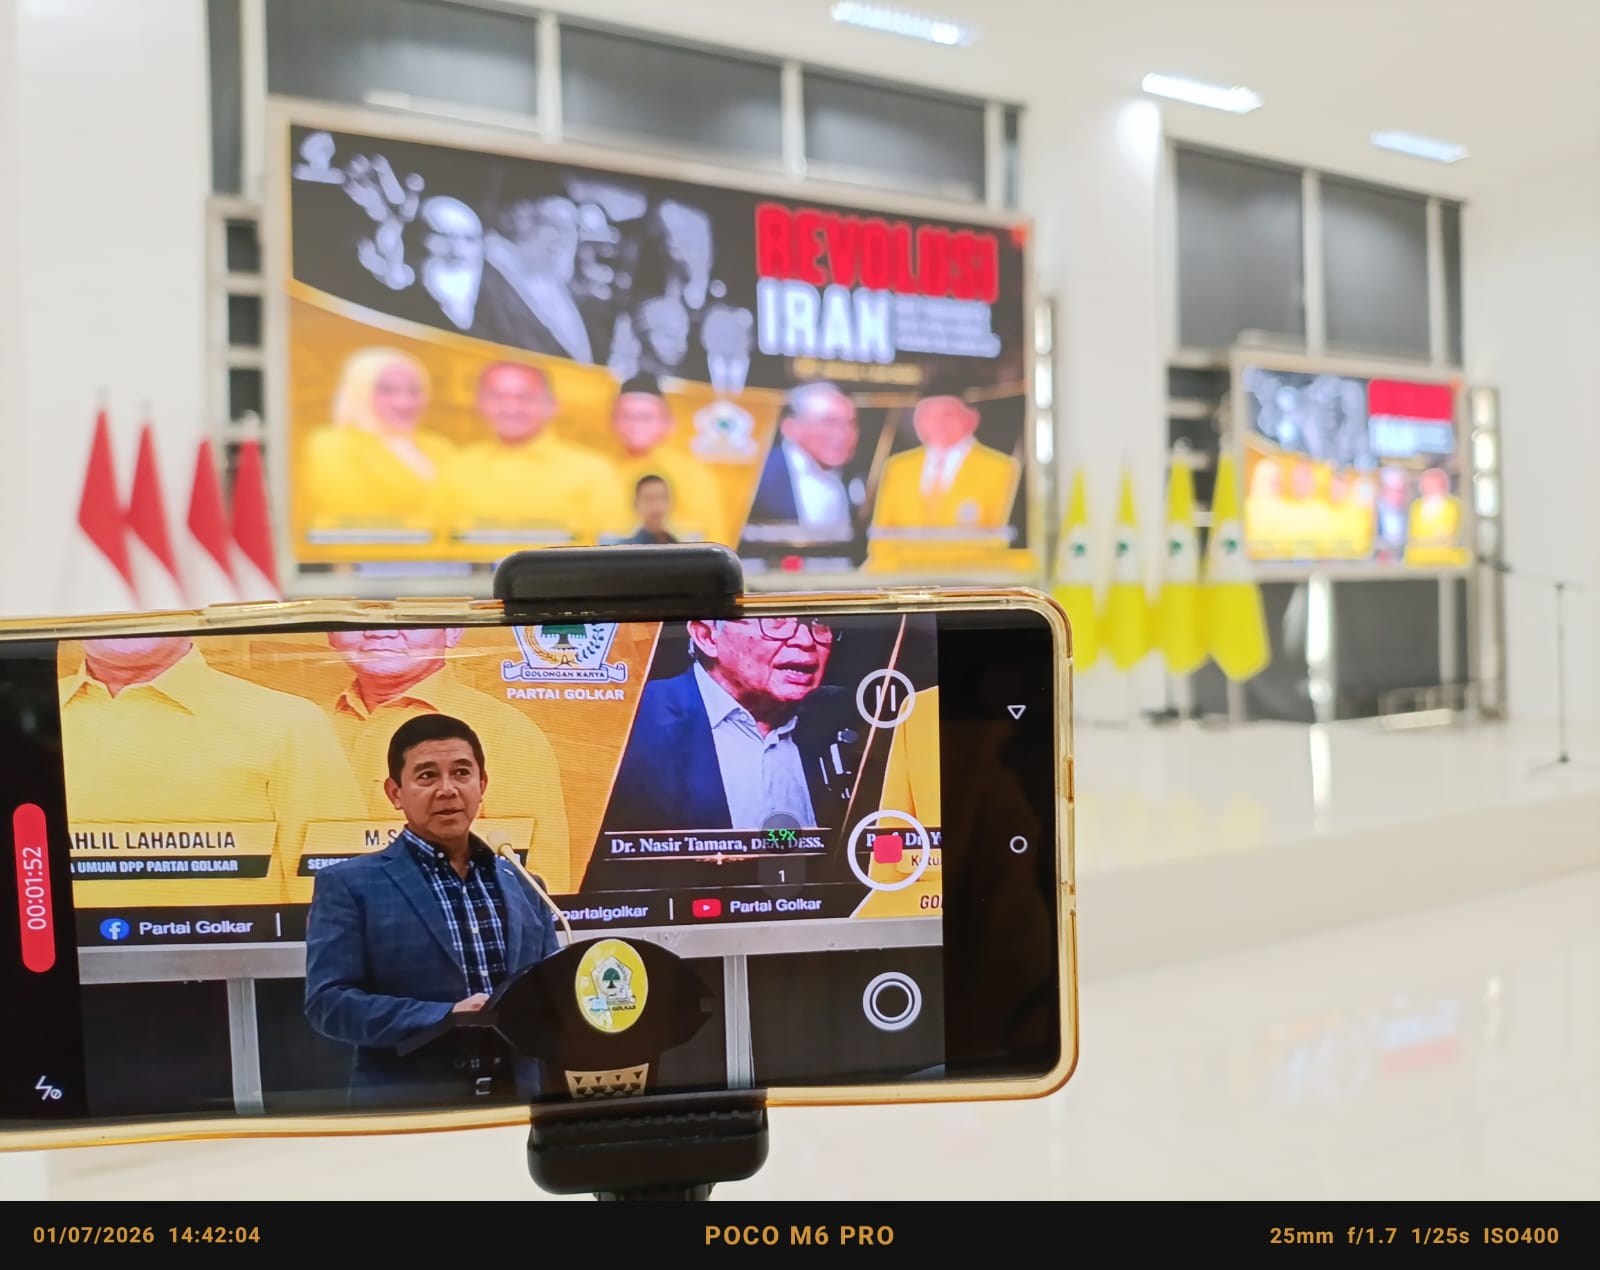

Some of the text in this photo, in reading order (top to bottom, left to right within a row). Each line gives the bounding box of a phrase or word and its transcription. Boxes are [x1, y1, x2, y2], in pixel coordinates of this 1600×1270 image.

[756, 203, 999, 304] REVOLUSI
[757, 277, 896, 363] IRAN
[525, 670, 574, 678] GOLONGAN
[506, 687, 625, 700] PARTAI GOLKAR
[125, 831, 236, 849] LAHADALIA
[611, 838, 636, 853] Dr.
[639, 838, 682, 853] Nasir
[684, 837, 747, 852] Tamara,
[77, 861, 117, 873] UMUM
[120, 861, 145, 873] DPP
[147, 860, 189, 873] PARTAI
[191, 860, 239, 872] GOLKAR
[777, 869, 786, 883] 1
[22, 846, 47, 930] 00:01:52
[730, 898, 822, 914] Partai Golkar
[139, 921, 191, 936] Partai
[196, 919, 253, 935] Golkar
